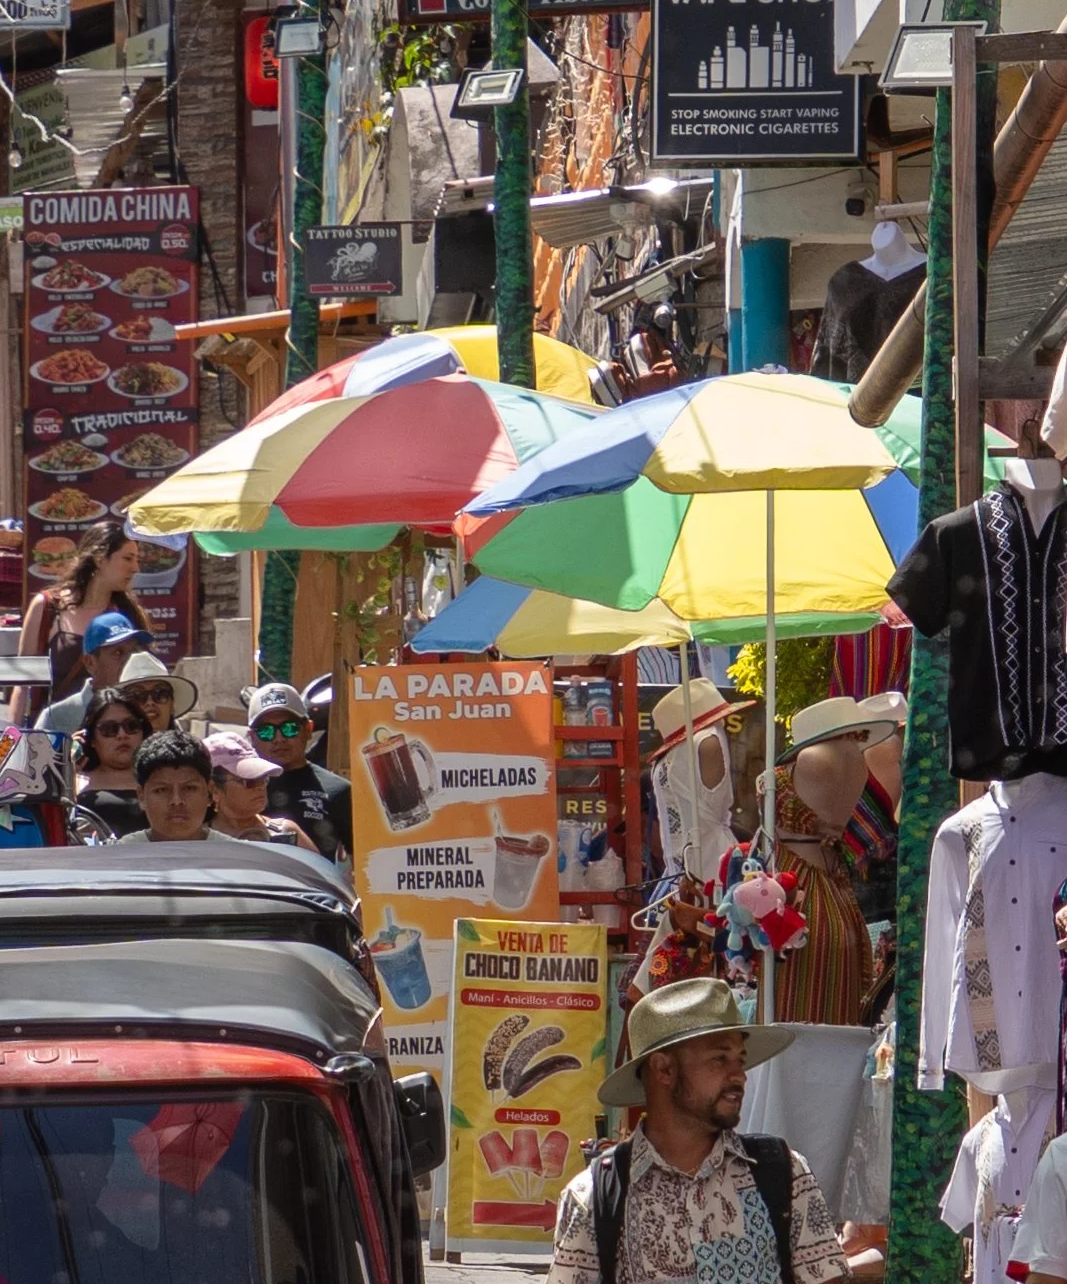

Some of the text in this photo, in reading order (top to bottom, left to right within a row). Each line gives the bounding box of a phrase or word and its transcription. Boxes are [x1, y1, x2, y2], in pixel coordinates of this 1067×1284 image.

[671, 107, 839, 120] STOP SMOKING START VAPING
[670, 122, 839, 135] ELECTRONIC CIGARETTES
[30, 192, 192, 225] COMIDA CHINA
[61, 236, 150, 252] ESPECIALIDAD
[306, 227, 398, 240] TATTOO STUDIO
[71, 410, 189, 434] TRADICIONAL
[354, 670, 549, 701] LA PARADA
[394, 700, 511, 722] San Juan
[441, 767, 537, 789] MICHELADAS
[406, 846, 473, 867] MINERAL
[397, 869, 485, 891] PREPARADA
[497, 930, 568, 954] VENTA DE
[464, 953, 600, 984] CHOCO BANANO
[468, 991, 495, 1004] Maní
[503, 994, 548, 1006] Anicillos
[556, 995, 594, 1008] Clásico
[385, 1036, 445, 1056] RANIZA
[506, 1110, 550, 1123] Helados
